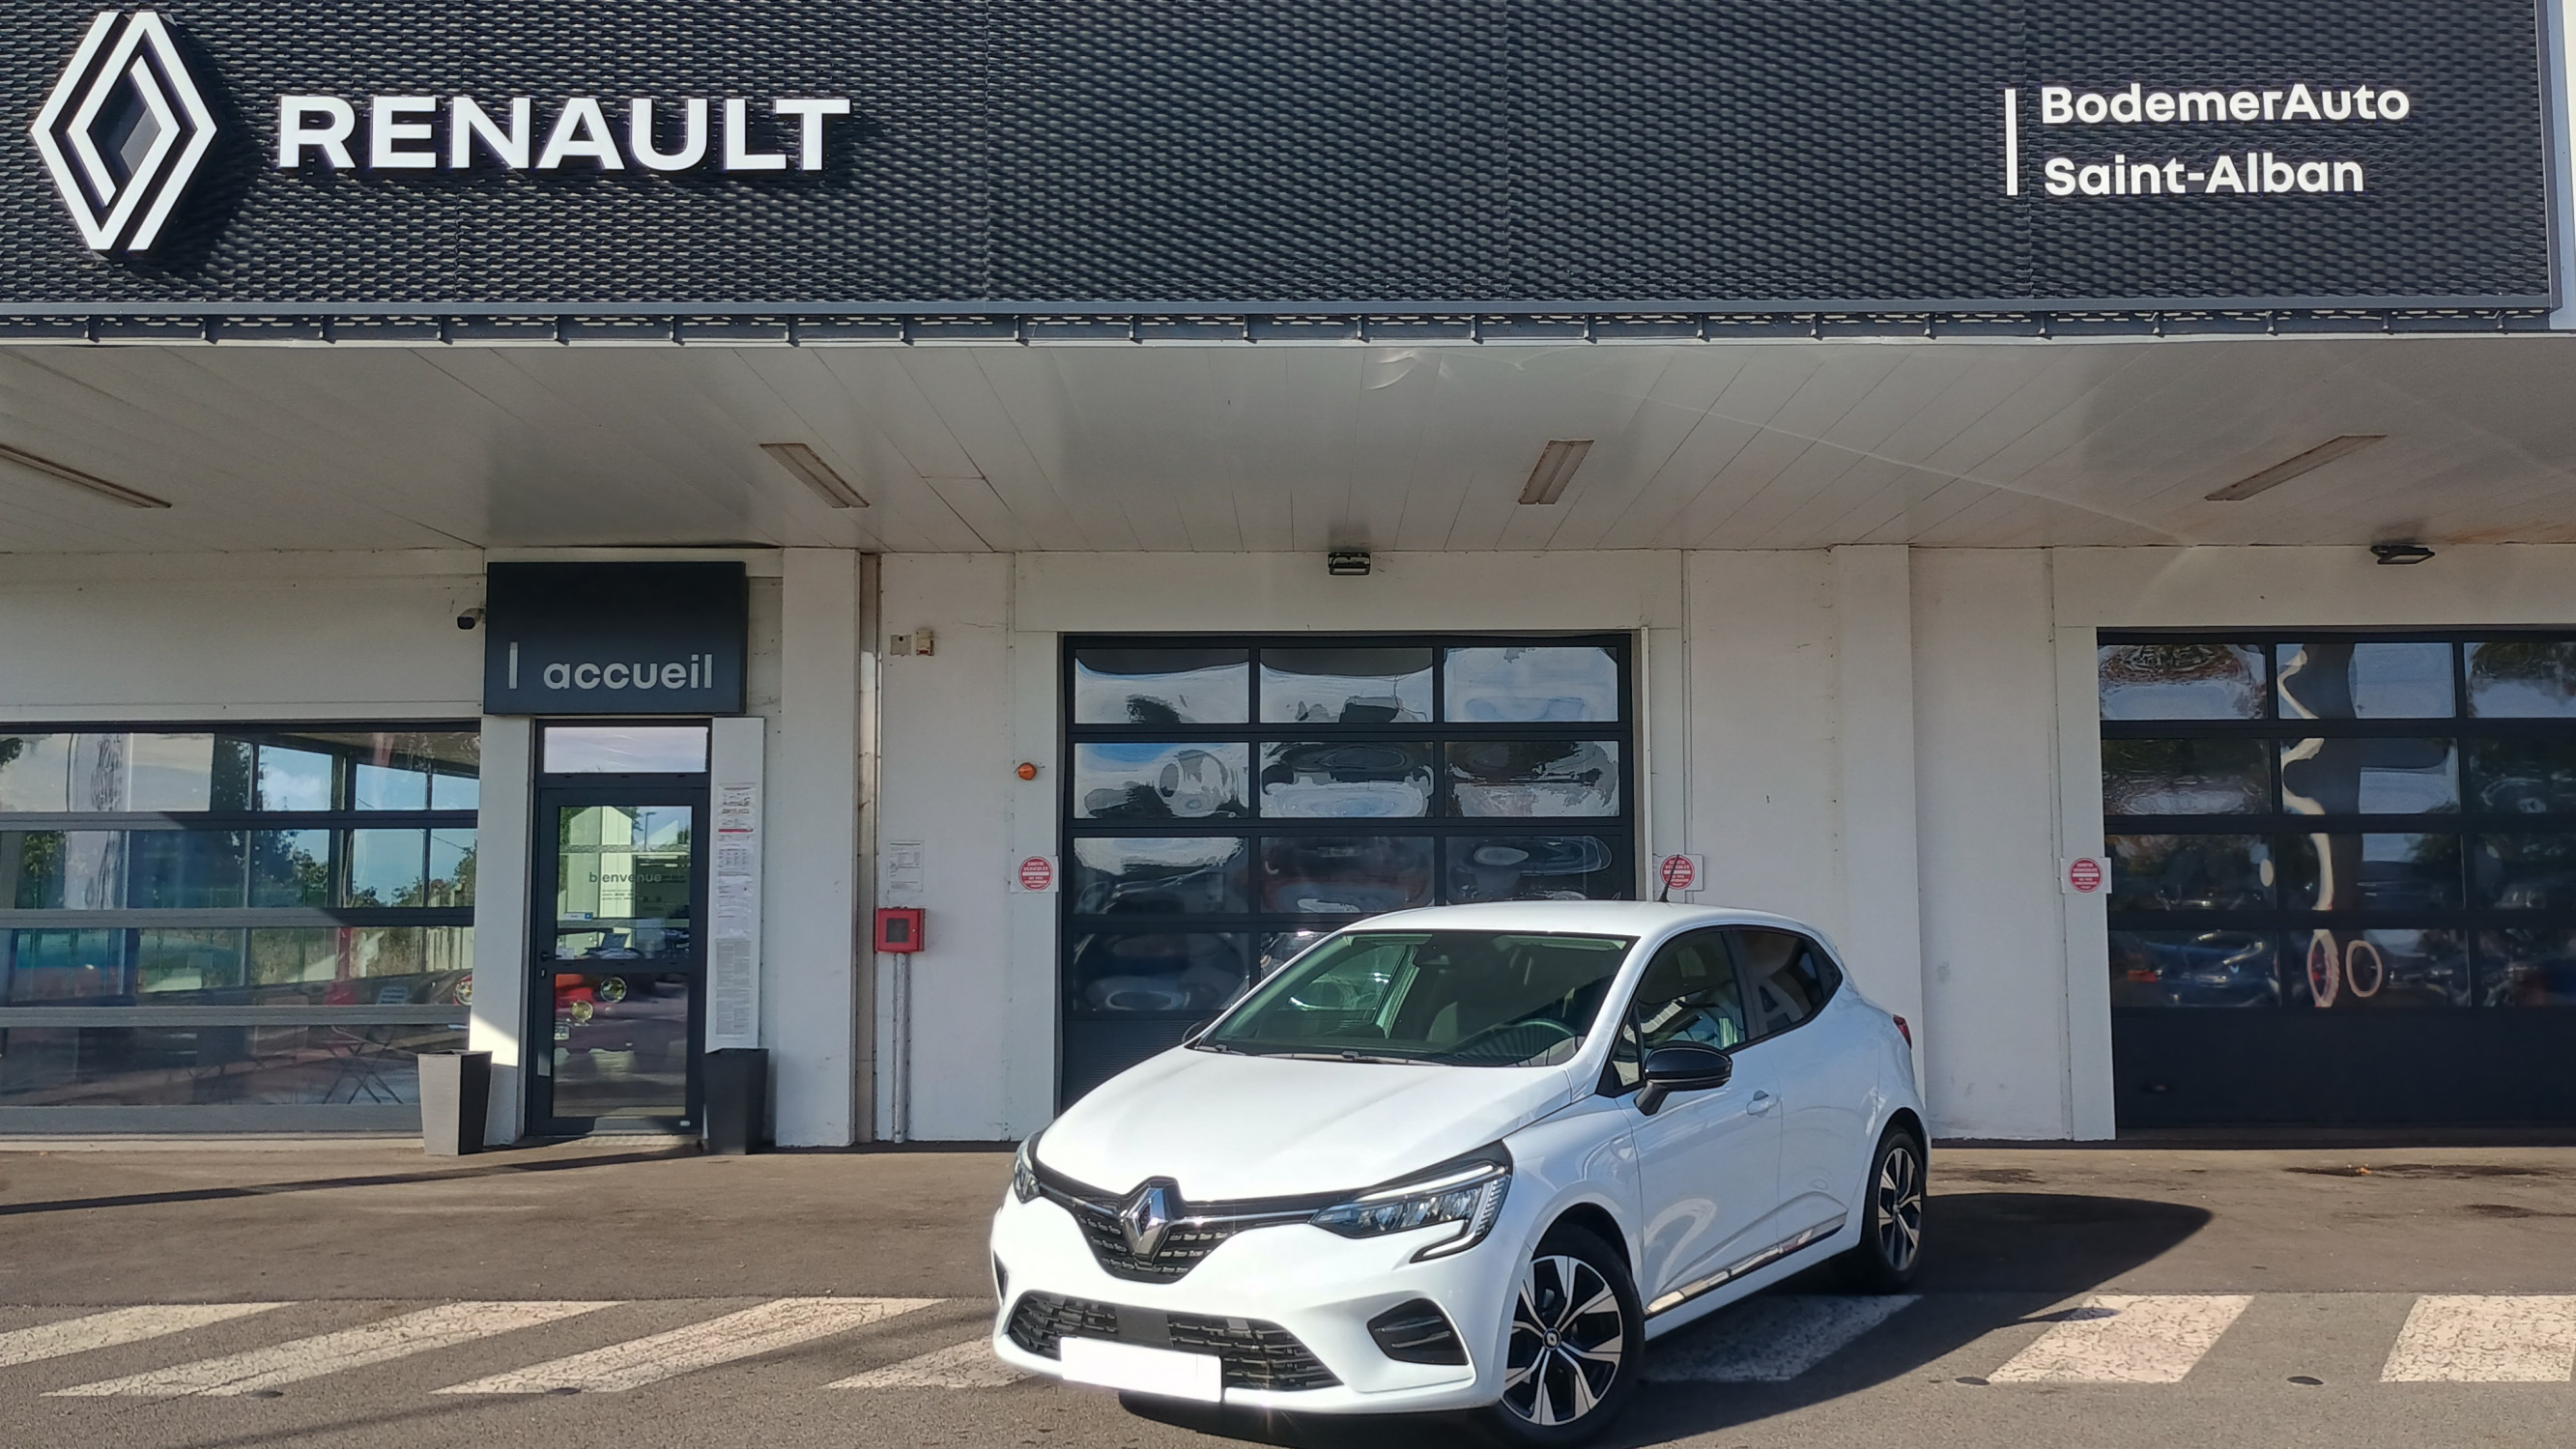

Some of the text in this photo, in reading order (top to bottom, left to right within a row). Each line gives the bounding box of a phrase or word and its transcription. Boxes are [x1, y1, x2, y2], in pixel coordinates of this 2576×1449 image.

[2042, 82, 2410, 124] BodemerAuto
[278, 96, 850, 171] RENAULT
[2045, 152, 2364, 196] Saint-Alban
[543, 654, 713, 690] accueil
[588, 871, 663, 883] benvenue
